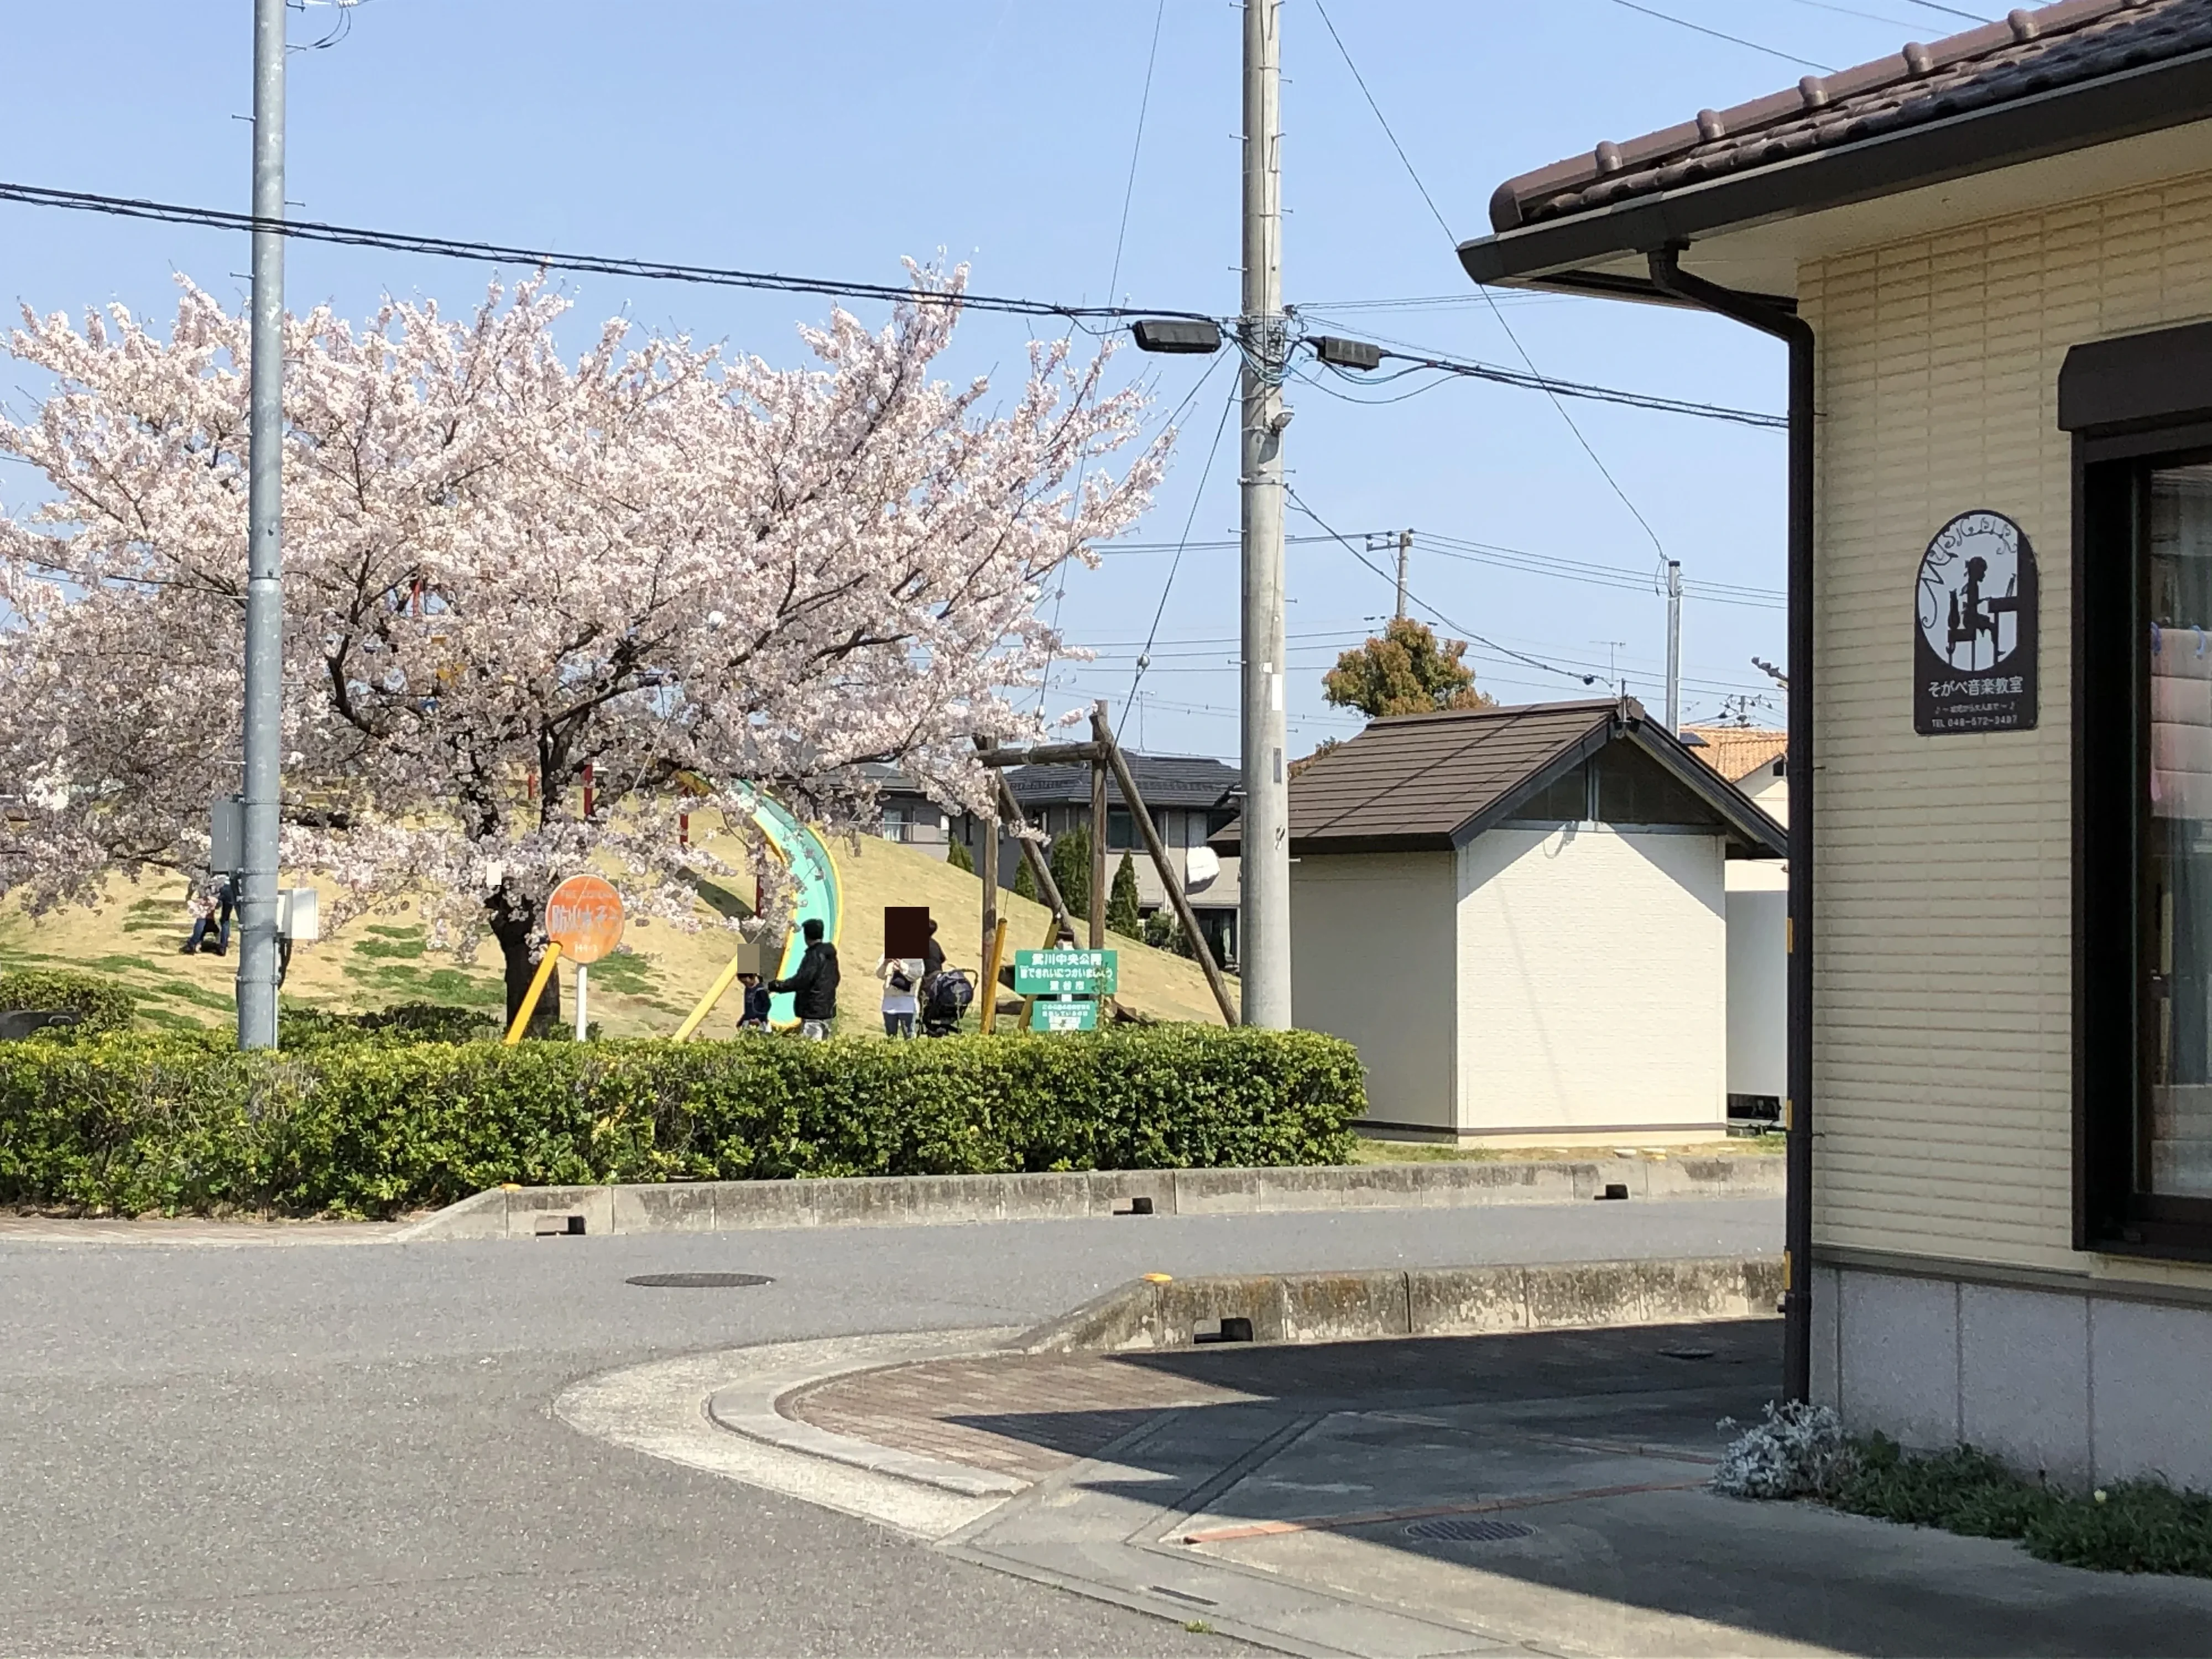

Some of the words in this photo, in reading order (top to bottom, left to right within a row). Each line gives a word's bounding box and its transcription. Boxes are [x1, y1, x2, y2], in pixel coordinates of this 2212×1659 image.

[1928, 676, 2023, 697] そがべ音楽教室
